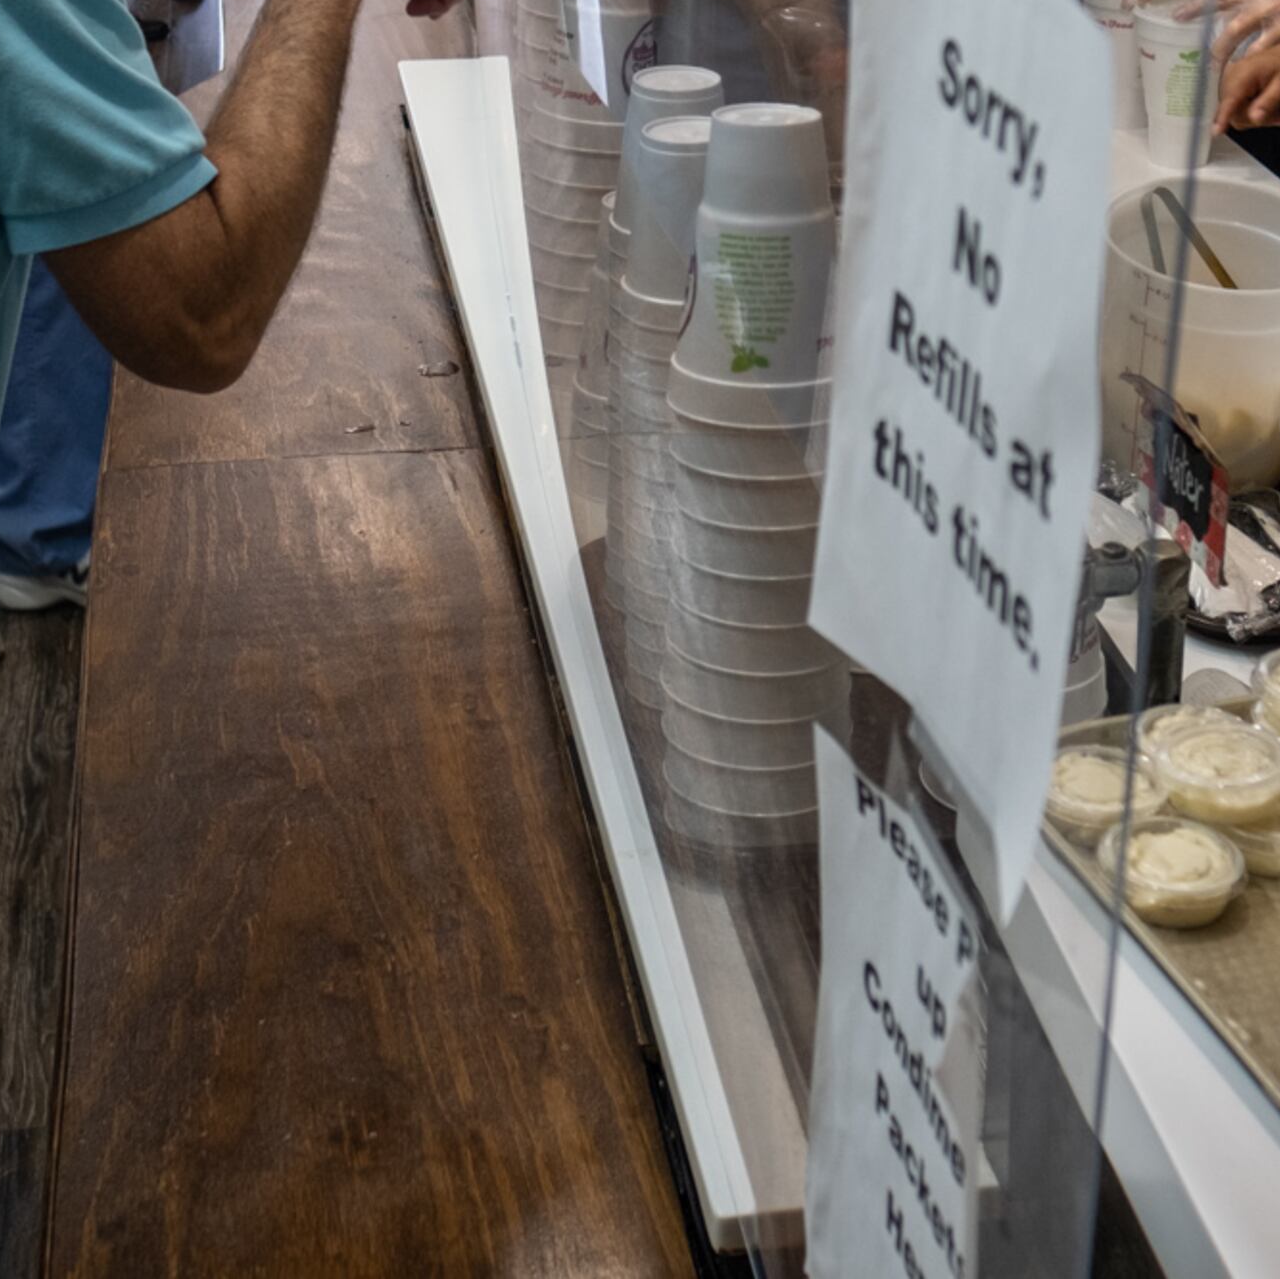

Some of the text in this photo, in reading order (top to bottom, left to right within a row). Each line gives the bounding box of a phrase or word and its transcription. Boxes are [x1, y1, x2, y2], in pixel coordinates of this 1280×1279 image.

[937, 37, 1047, 201] Sorry,
[951, 203, 1003, 309] No
[887, 289, 1055, 523] Refills at
[873, 417, 1040, 675] this time.
[853, 772, 950, 939] Please
[863, 959, 968, 1189] Condime
[915, 962, 948, 1041] up
